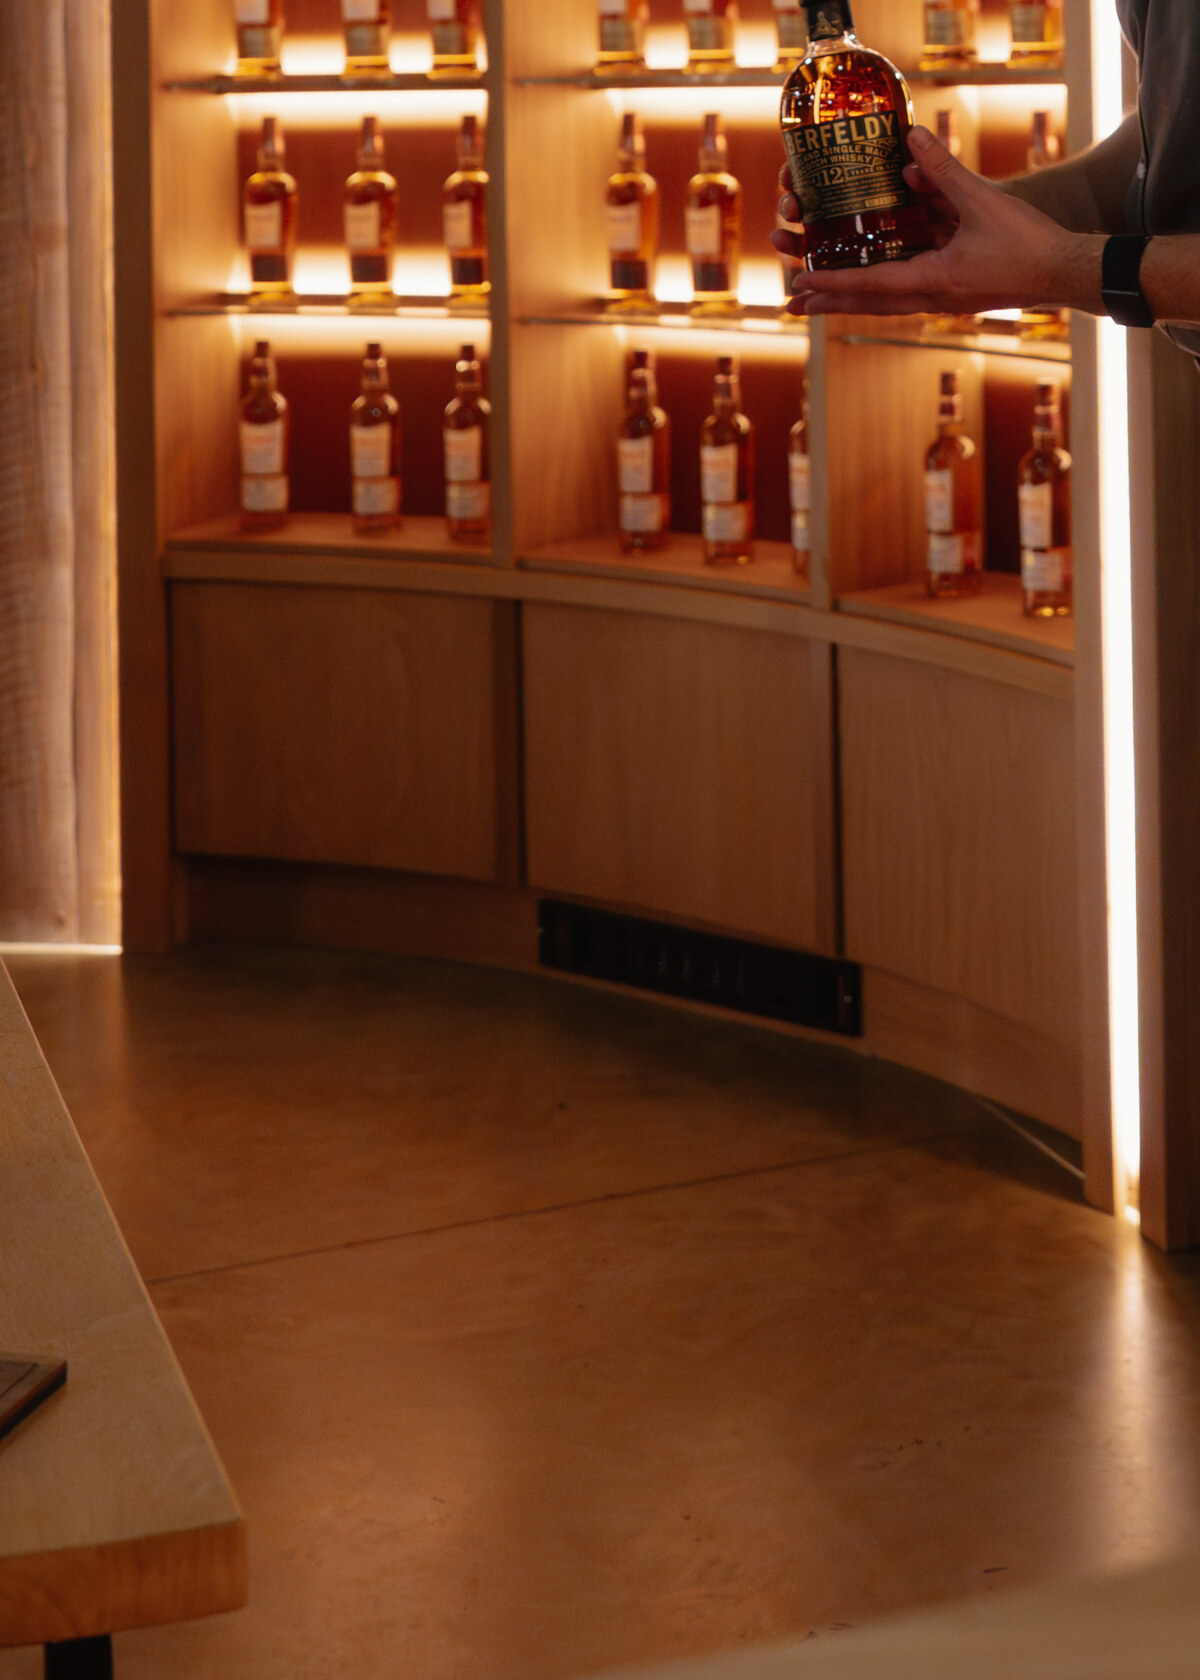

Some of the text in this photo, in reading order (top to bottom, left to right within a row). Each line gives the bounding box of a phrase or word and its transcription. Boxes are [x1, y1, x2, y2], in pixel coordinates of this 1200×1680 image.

[822, 144, 861, 156] SINGLE
[864, 146, 889, 158] MALT
[830, 153, 872, 164] WHISKY
[820, 166, 845, 187] 12
